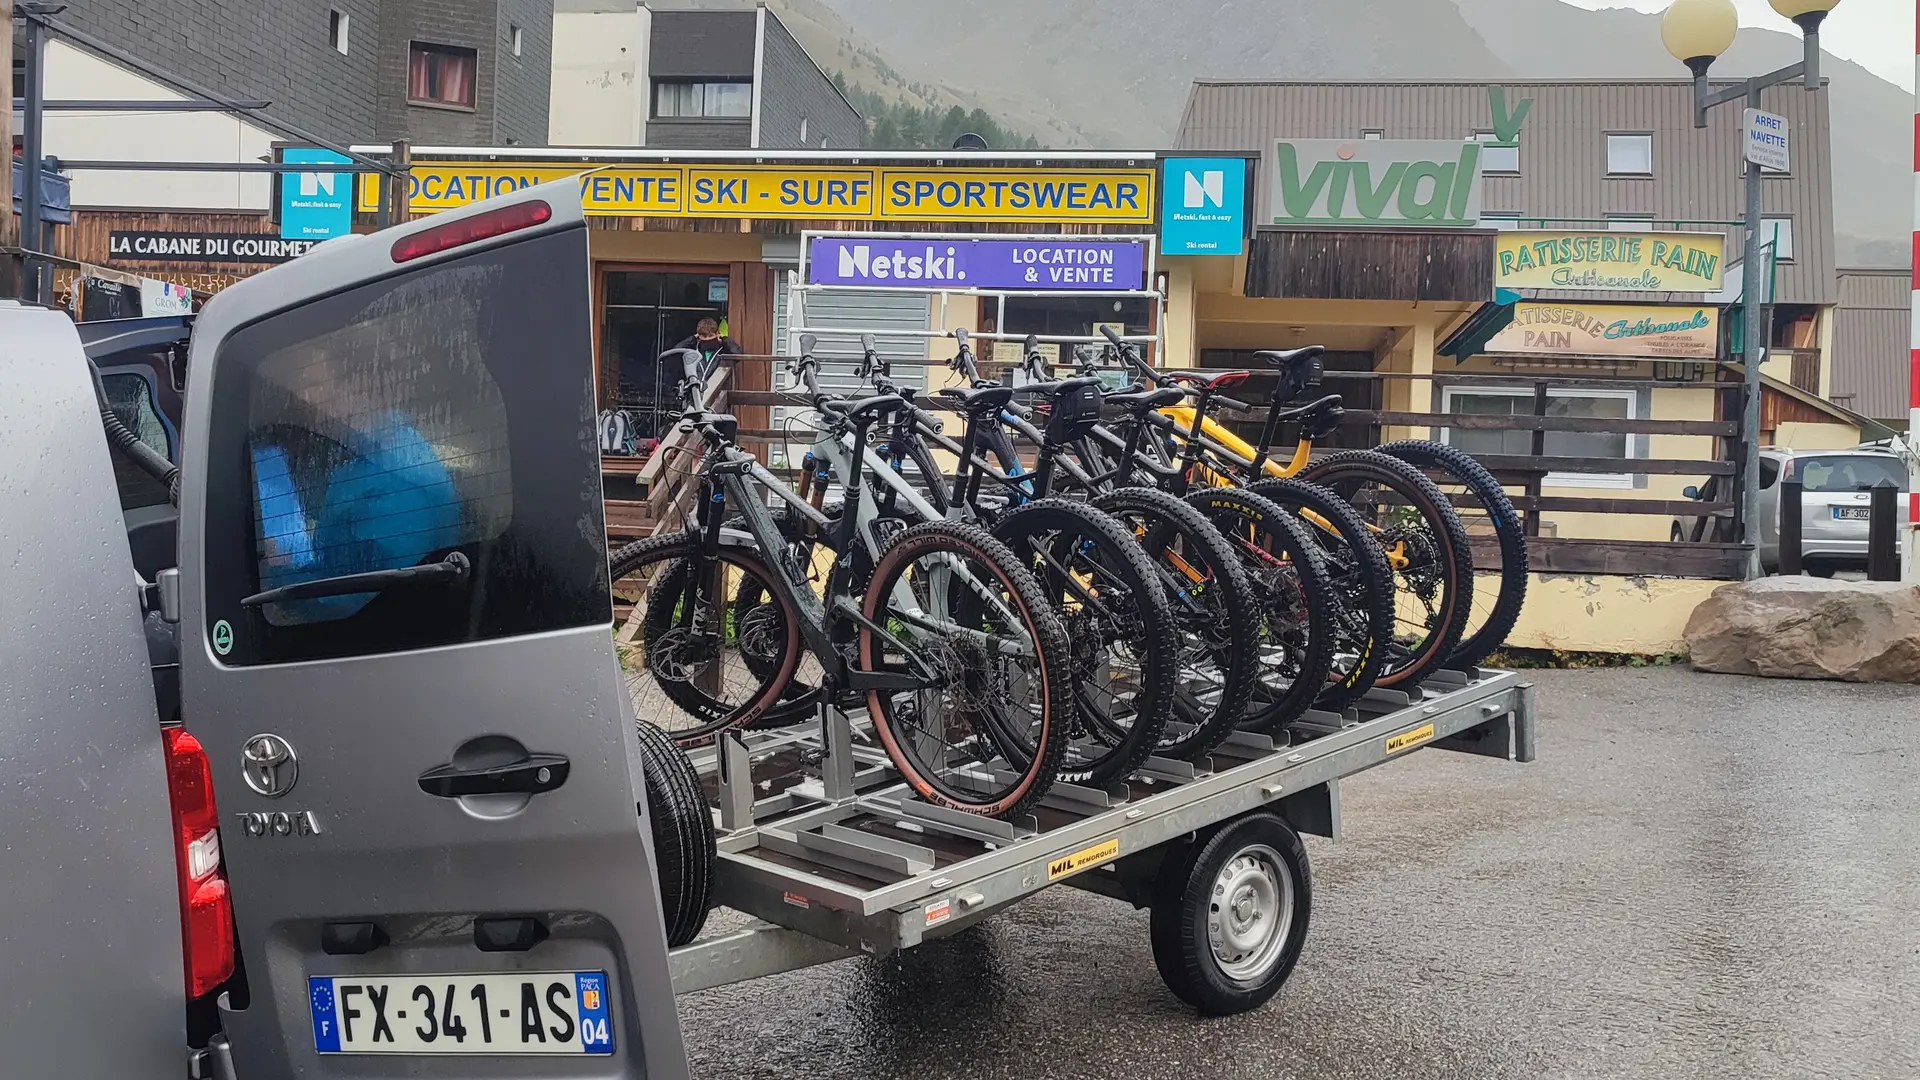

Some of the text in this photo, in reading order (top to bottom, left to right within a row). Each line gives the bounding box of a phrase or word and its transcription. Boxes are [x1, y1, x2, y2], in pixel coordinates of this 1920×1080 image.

[1755, 114, 1781, 130] ARRET
[1751, 129, 1785, 148] NAVETTE
[409, 175, 539, 200] OCATION
[694, 178, 748, 205] SKI
[779, 179, 870, 207] SURF
[890, 180, 1139, 210] SPORTSWEAR
[1184, 170, 1223, 208] N
[111, 236, 131, 253] LA
[134, 236, 201, 255] CABANE
[205, 238, 229, 256] DU
[1012, 247, 1114, 266] LOCATION
[1186, 241, 1217, 249] Ski rental
[838, 244, 967, 281] Netski.
[1499, 236, 1718, 281] PATISSERIE PAIN
[1024, 266, 1114, 284] & VENTE
[155, 297, 177, 309] GROM
[1501, 306, 1605, 339] ATISSERIE
[1603, 310, 1711, 339] Artisanale
[1524, 330, 1571, 348] PAIN
[1211, 500, 1264, 521] MAXXIS
[1840, 509, 1869, 518] AF-302
[692, 602, 708, 637] FOX
[1346, 635, 1374, 688] MAXXIS
[1388, 730, 1433, 751] MIL REMORQUES
[1056, 770, 1094, 782] MAXX
[929, 791, 1000, 815] SCHWALBE
[235, 811, 321, 837] TOYOTA
[1051, 847, 1117, 876] MIL REMORQUES
[340, 982, 575, 1043] FX-341-AS
[321, 1020, 329, 1036] F
[582, 1018, 609, 1045] 04
